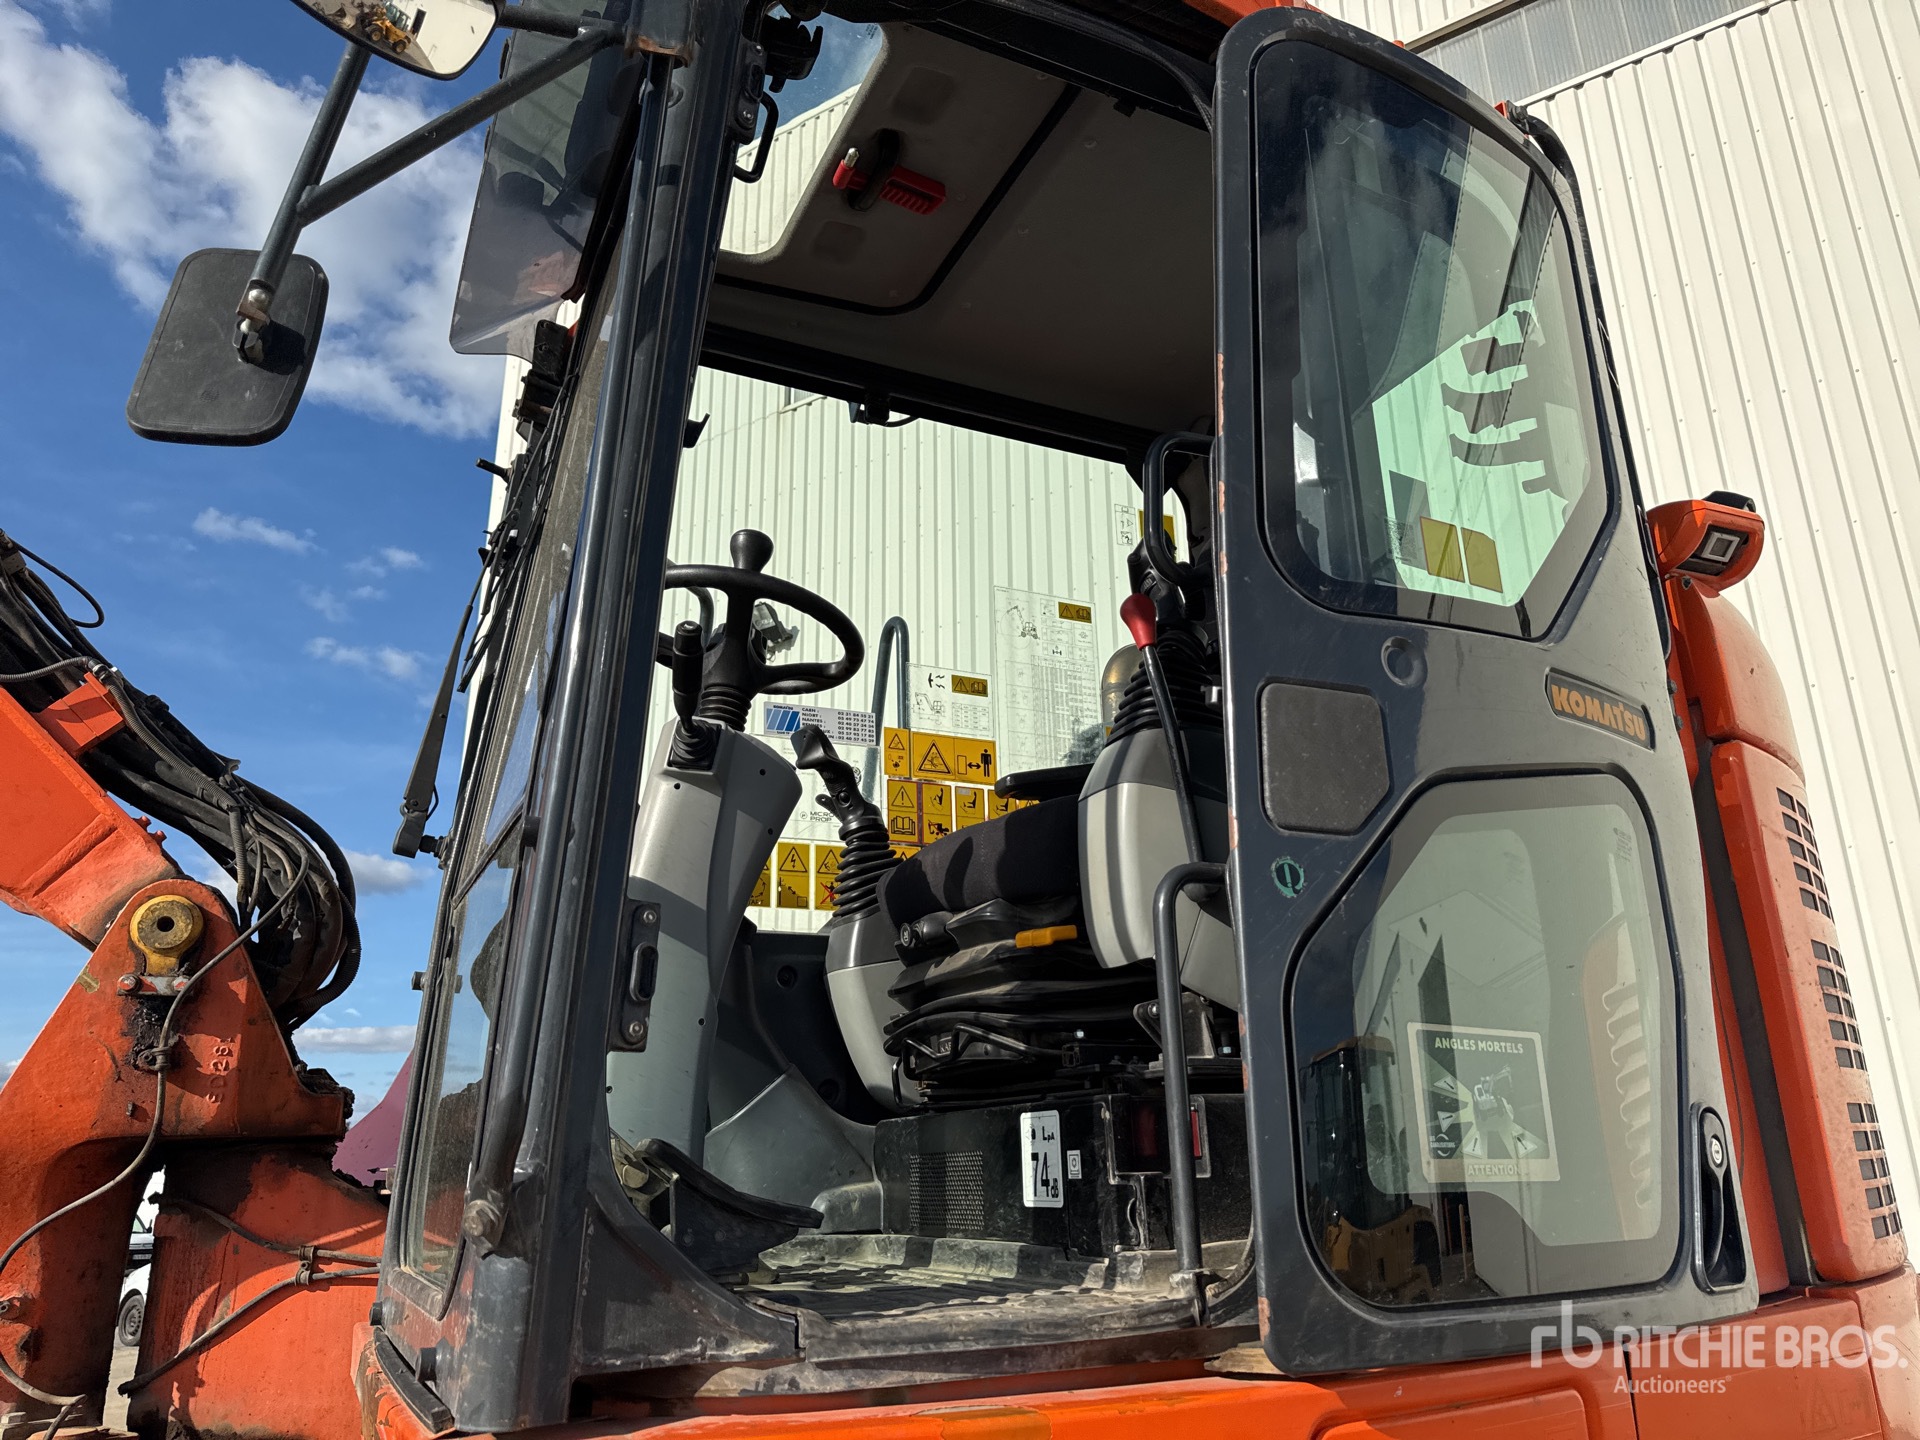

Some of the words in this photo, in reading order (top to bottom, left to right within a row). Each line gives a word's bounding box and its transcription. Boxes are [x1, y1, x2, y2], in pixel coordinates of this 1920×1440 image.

[1551, 684, 1646, 741] KOMATSU
[1435, 1037, 1476, 1050] ANGLES
[1478, 1040, 1524, 1054] MORTELS
[1031, 1152, 1050, 1197] 74
[1467, 1164, 1521, 1176] ATTENTION
